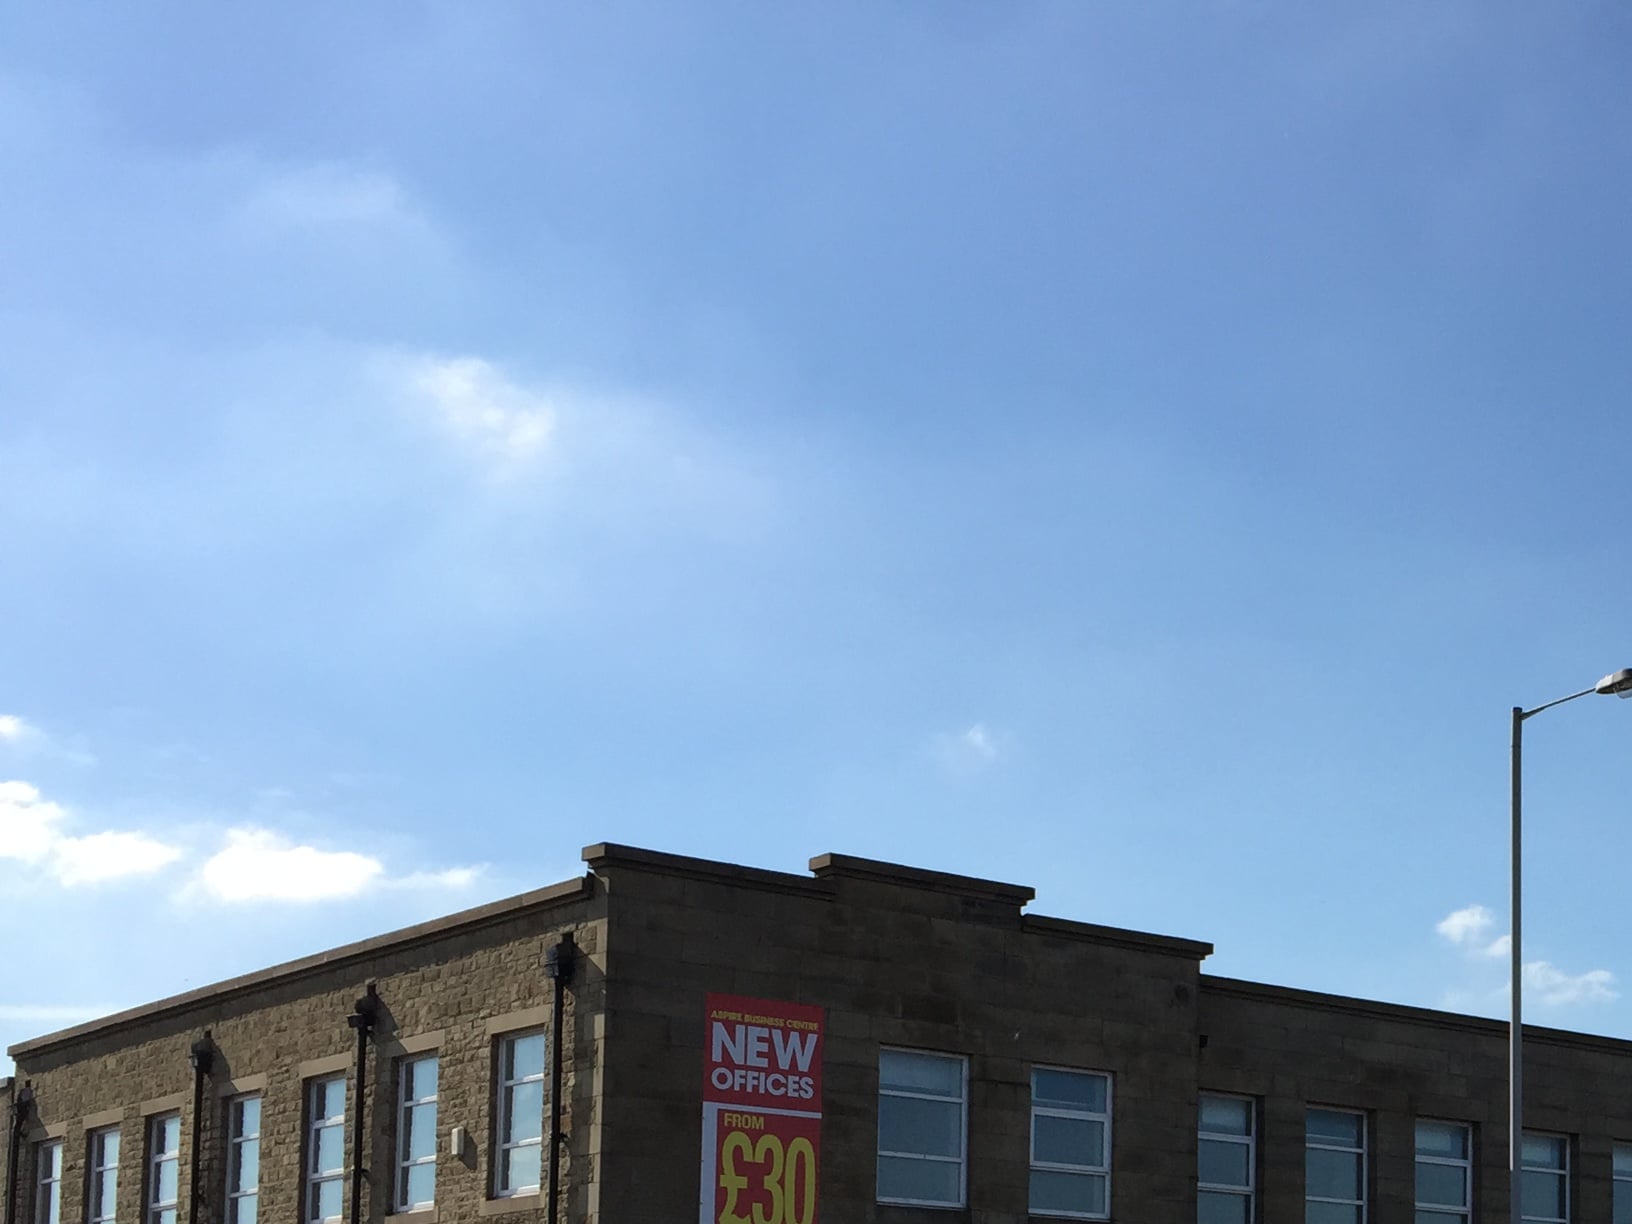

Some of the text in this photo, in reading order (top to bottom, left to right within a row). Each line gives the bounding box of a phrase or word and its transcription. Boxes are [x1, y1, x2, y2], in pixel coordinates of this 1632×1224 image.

[744, 1014, 785, 1027] BUSINESS
[787, 1018, 819, 1031] CENTRE
[711, 1021, 818, 1072] NEW
[711, 1067, 815, 1099] OFFICES
[724, 1113, 765, 1130] FROM
